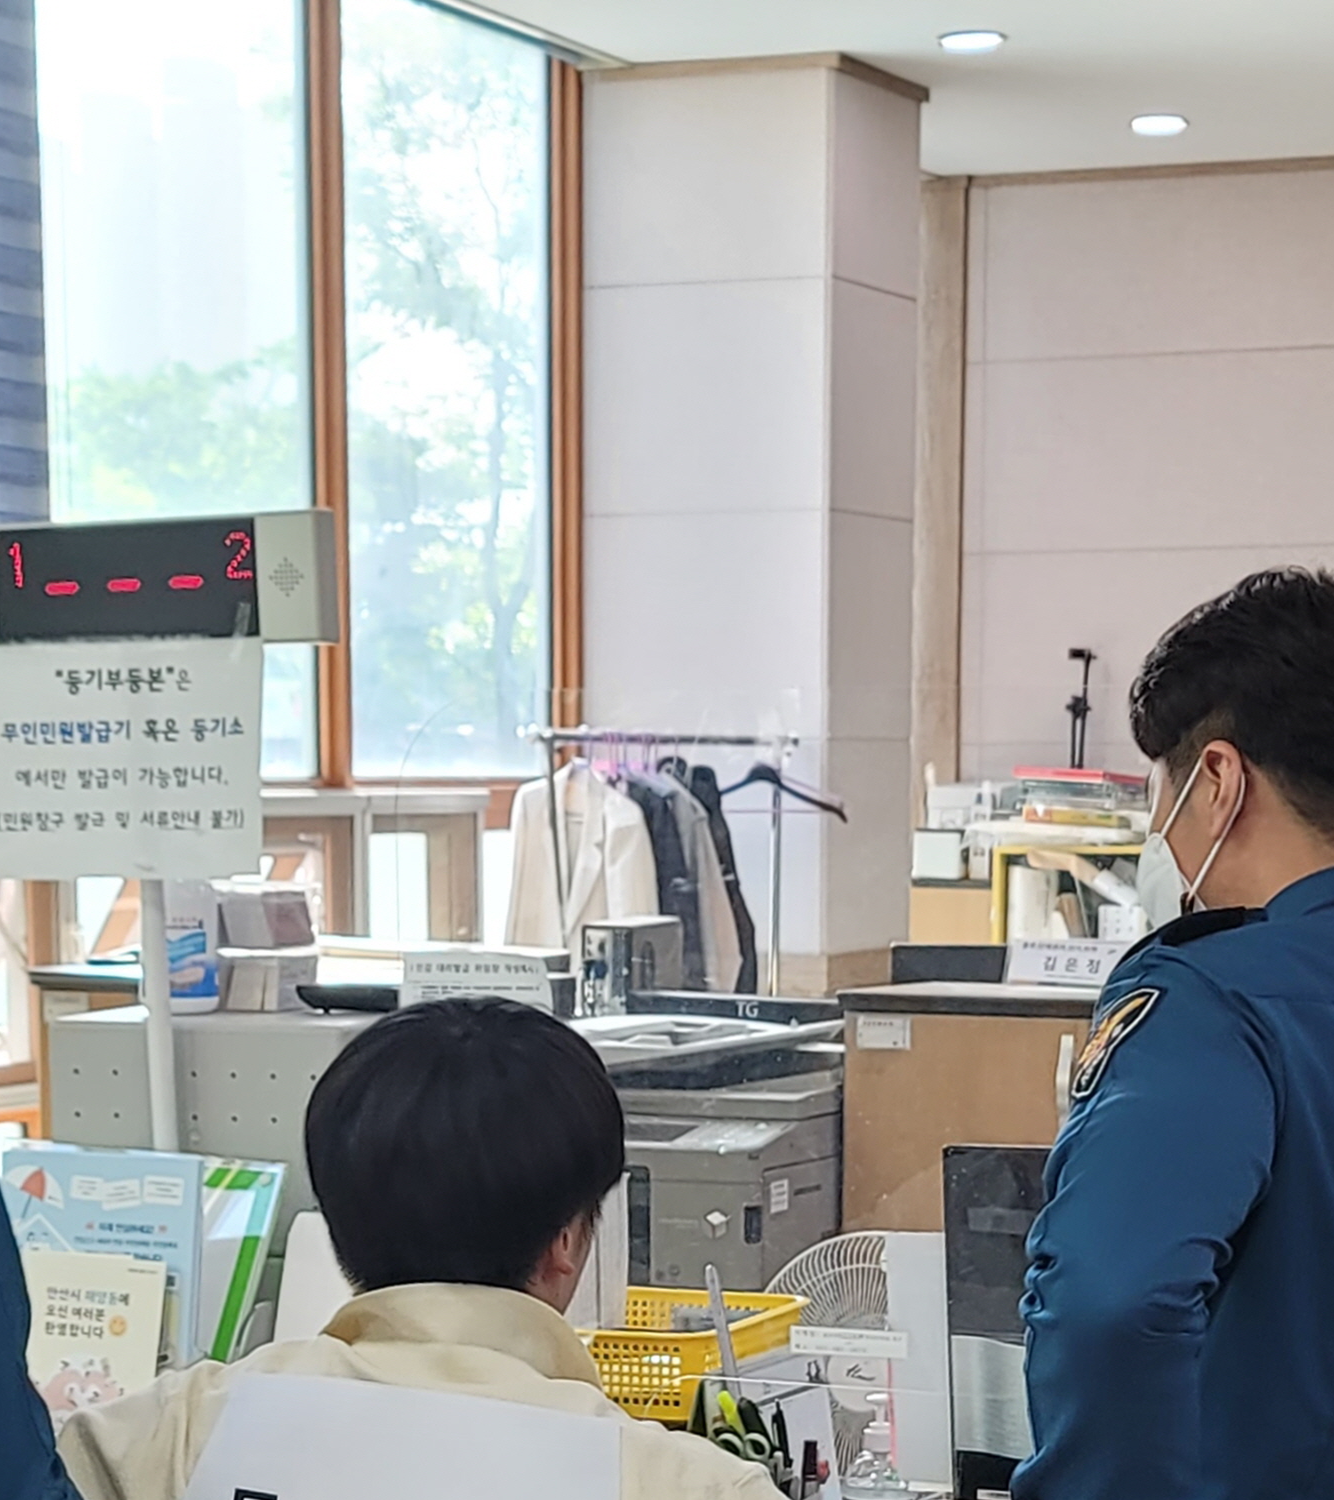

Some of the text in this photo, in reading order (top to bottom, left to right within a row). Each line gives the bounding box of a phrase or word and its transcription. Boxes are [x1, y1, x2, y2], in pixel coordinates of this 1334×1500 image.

[223, 530, 255, 581] 2
[1, 717, 245, 745] 무인민원발급기 혹은 등기소
[15, 765, 230, 790] 에서만 발급이 가능합니다.
[735, 1000, 759, 1019] TG
